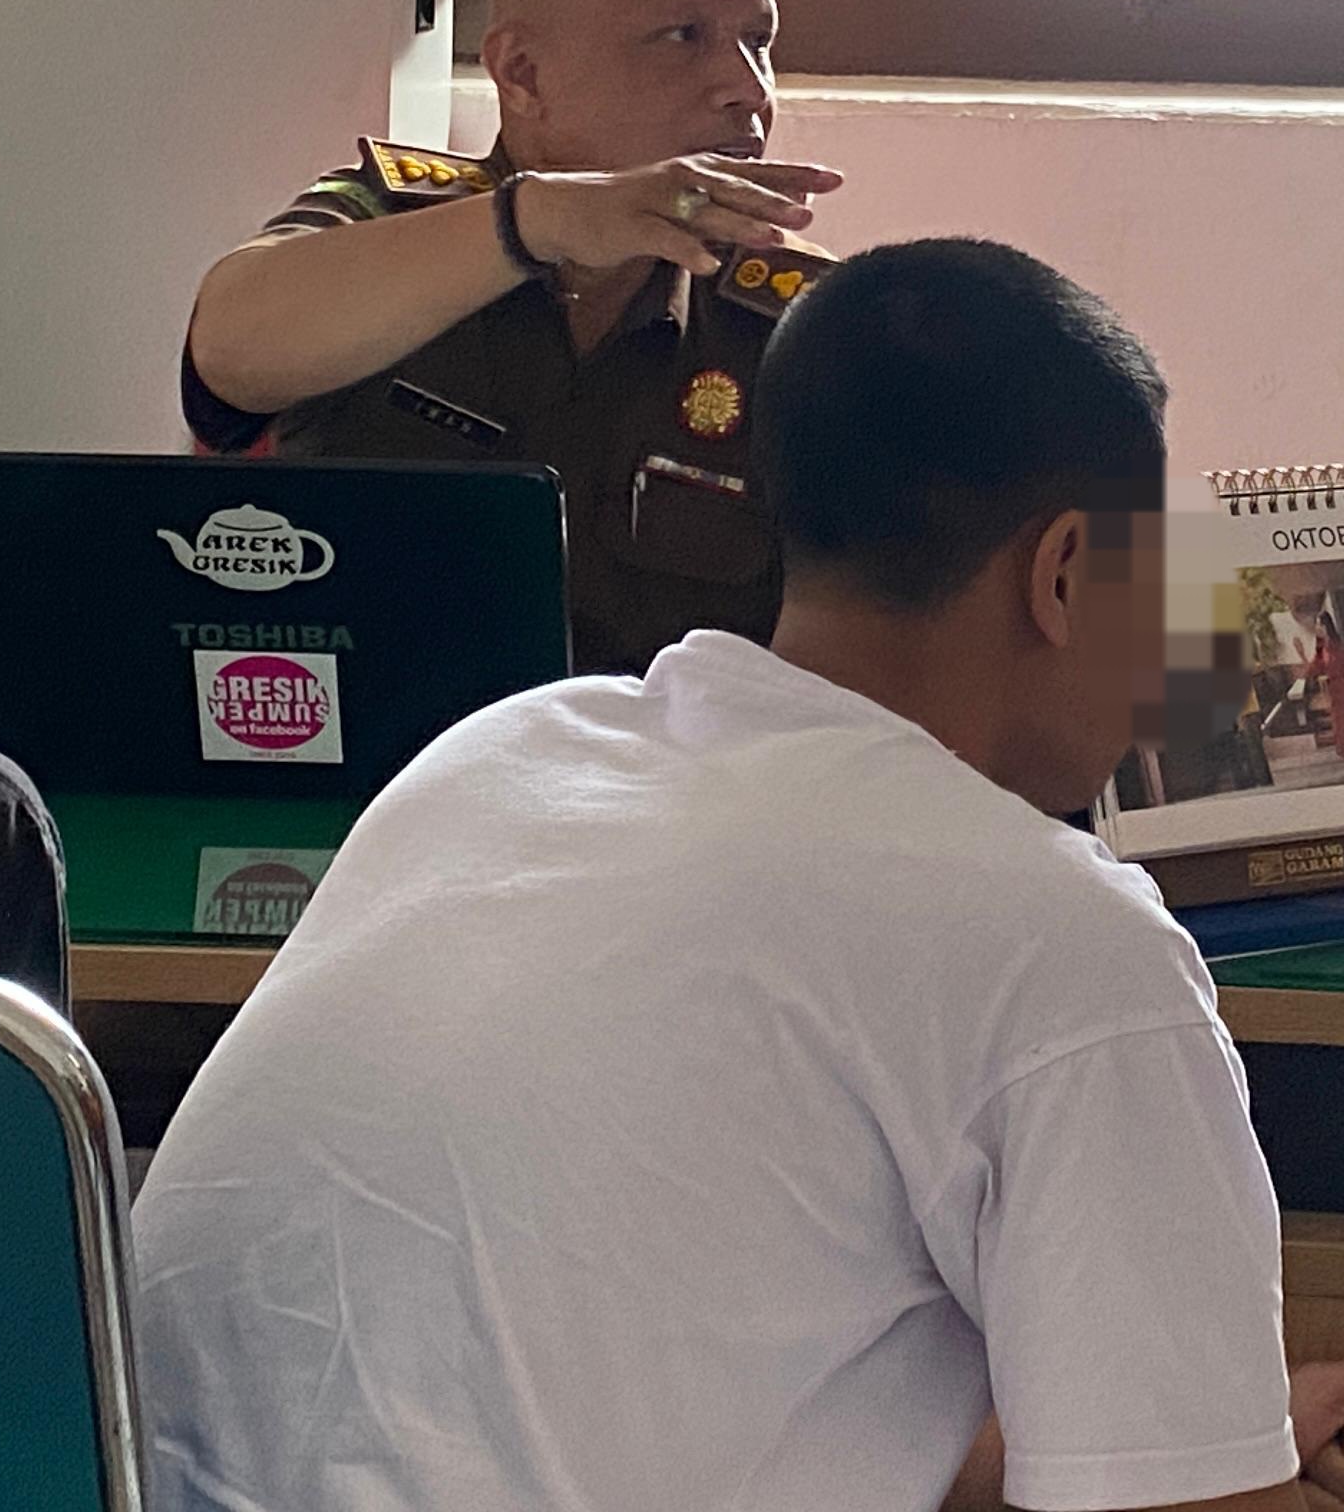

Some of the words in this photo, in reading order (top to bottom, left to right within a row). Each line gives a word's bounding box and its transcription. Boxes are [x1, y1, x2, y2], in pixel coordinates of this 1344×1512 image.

[202, 533, 294, 555] AREK
[191, 555, 298, 576] GRESIK
[169, 622, 355, 650] TOSHIBA
[211, 675, 328, 703] GRESIK
[209, 701, 331, 724] SUMPEK
[249, 722, 311, 737] facebook
[1285, 855, 1344, 874] GARAM
